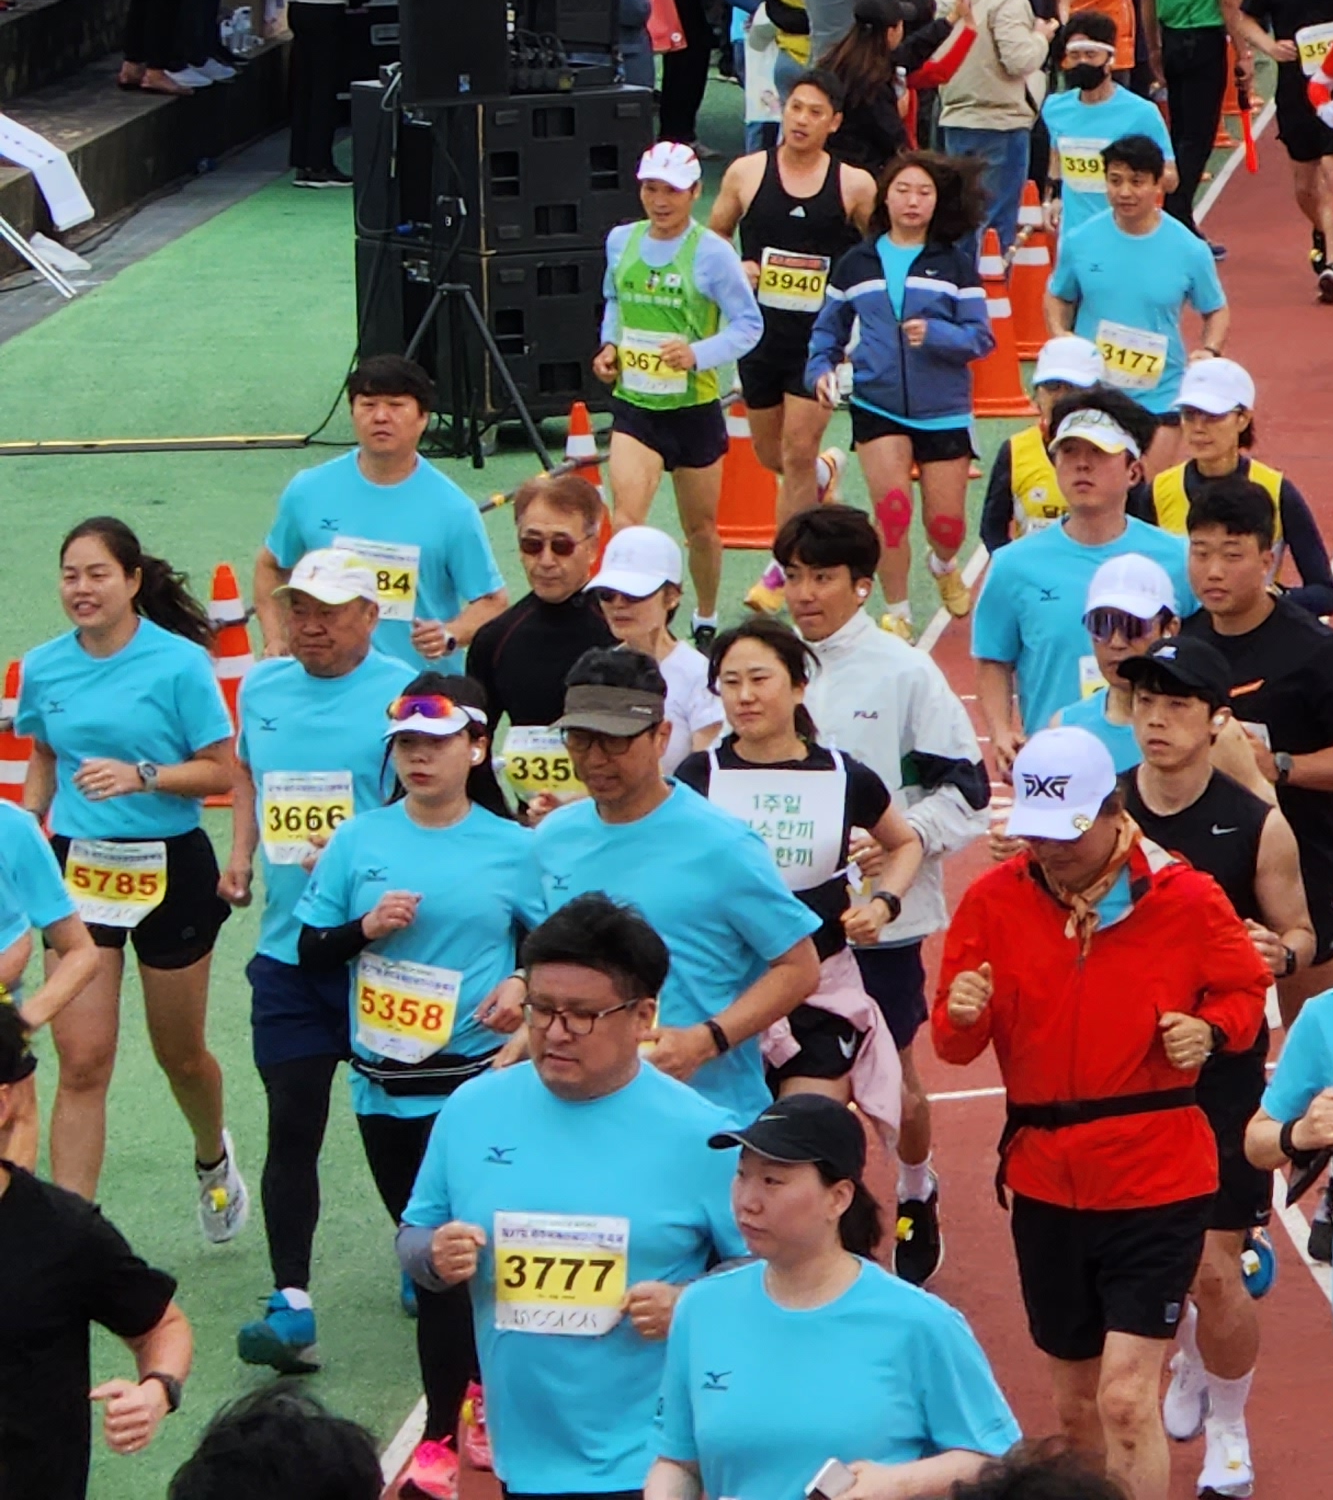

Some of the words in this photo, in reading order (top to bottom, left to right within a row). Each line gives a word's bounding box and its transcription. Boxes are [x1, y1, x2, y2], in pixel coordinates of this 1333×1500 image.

[1065, 156, 1105, 174] 339
[765, 269, 823, 294] 3940
[1101, 341, 1160, 375] 3177
[376, 570, 412, 596] 84
[1022, 773, 1072, 801] PXG
[268, 804, 346, 833] 3666
[753, 794, 801, 815] 1주일
[777, 846, 813, 868] 한끼
[72, 864, 159, 896] 5785
[359, 988, 444, 1033] 5358
[503, 1254, 616, 1291] 3777
